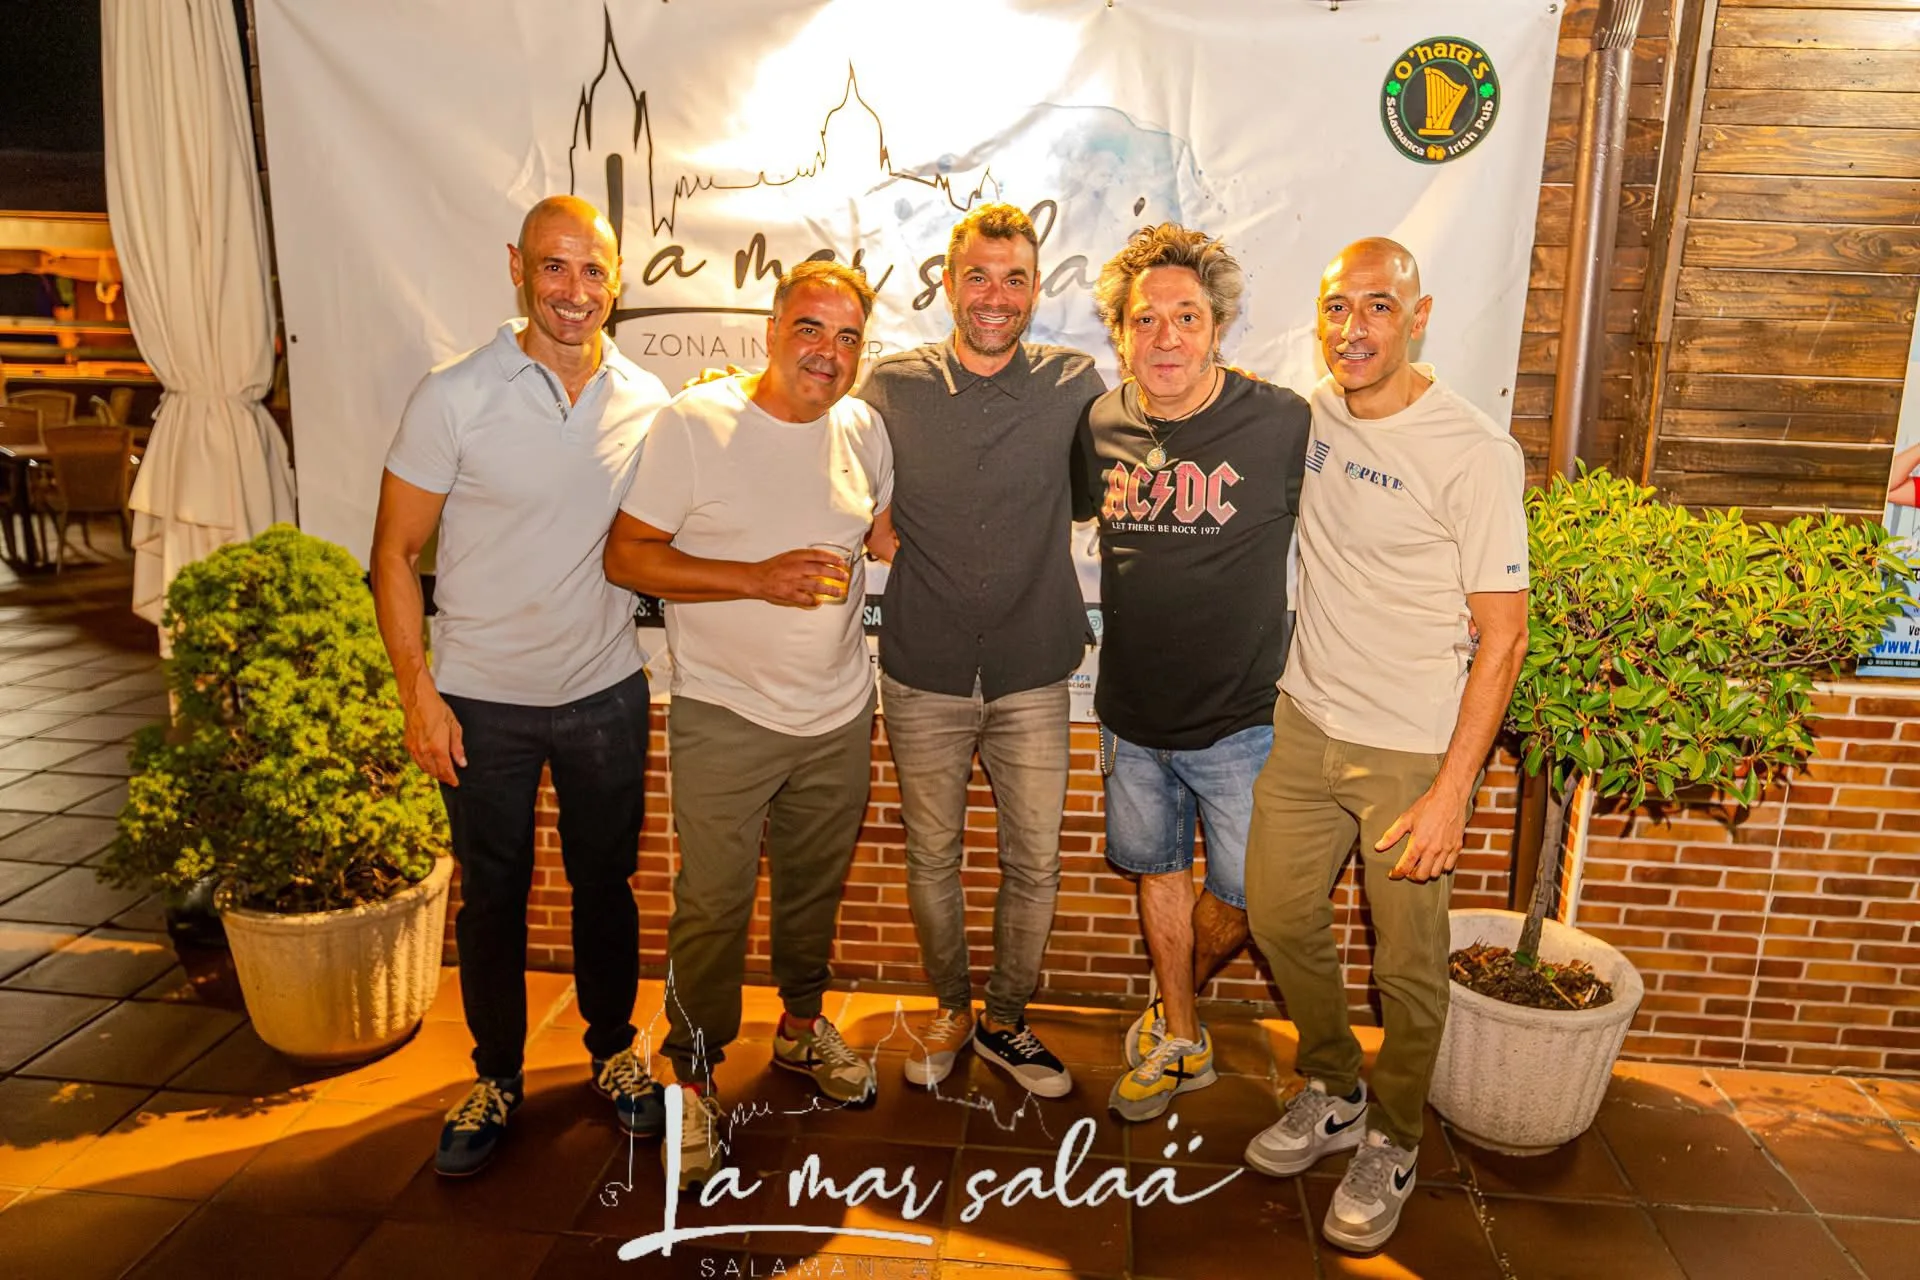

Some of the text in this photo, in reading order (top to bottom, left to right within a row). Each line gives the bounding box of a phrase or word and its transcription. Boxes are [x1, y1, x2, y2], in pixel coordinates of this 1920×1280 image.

[1386, 96, 1425, 156] Salamanca
[1448, 100, 1494, 155] Irish Pub
[641, 333, 729, 358] ZONA
[1111, 521, 1221, 536] LET THERE BE ROCK 1977
